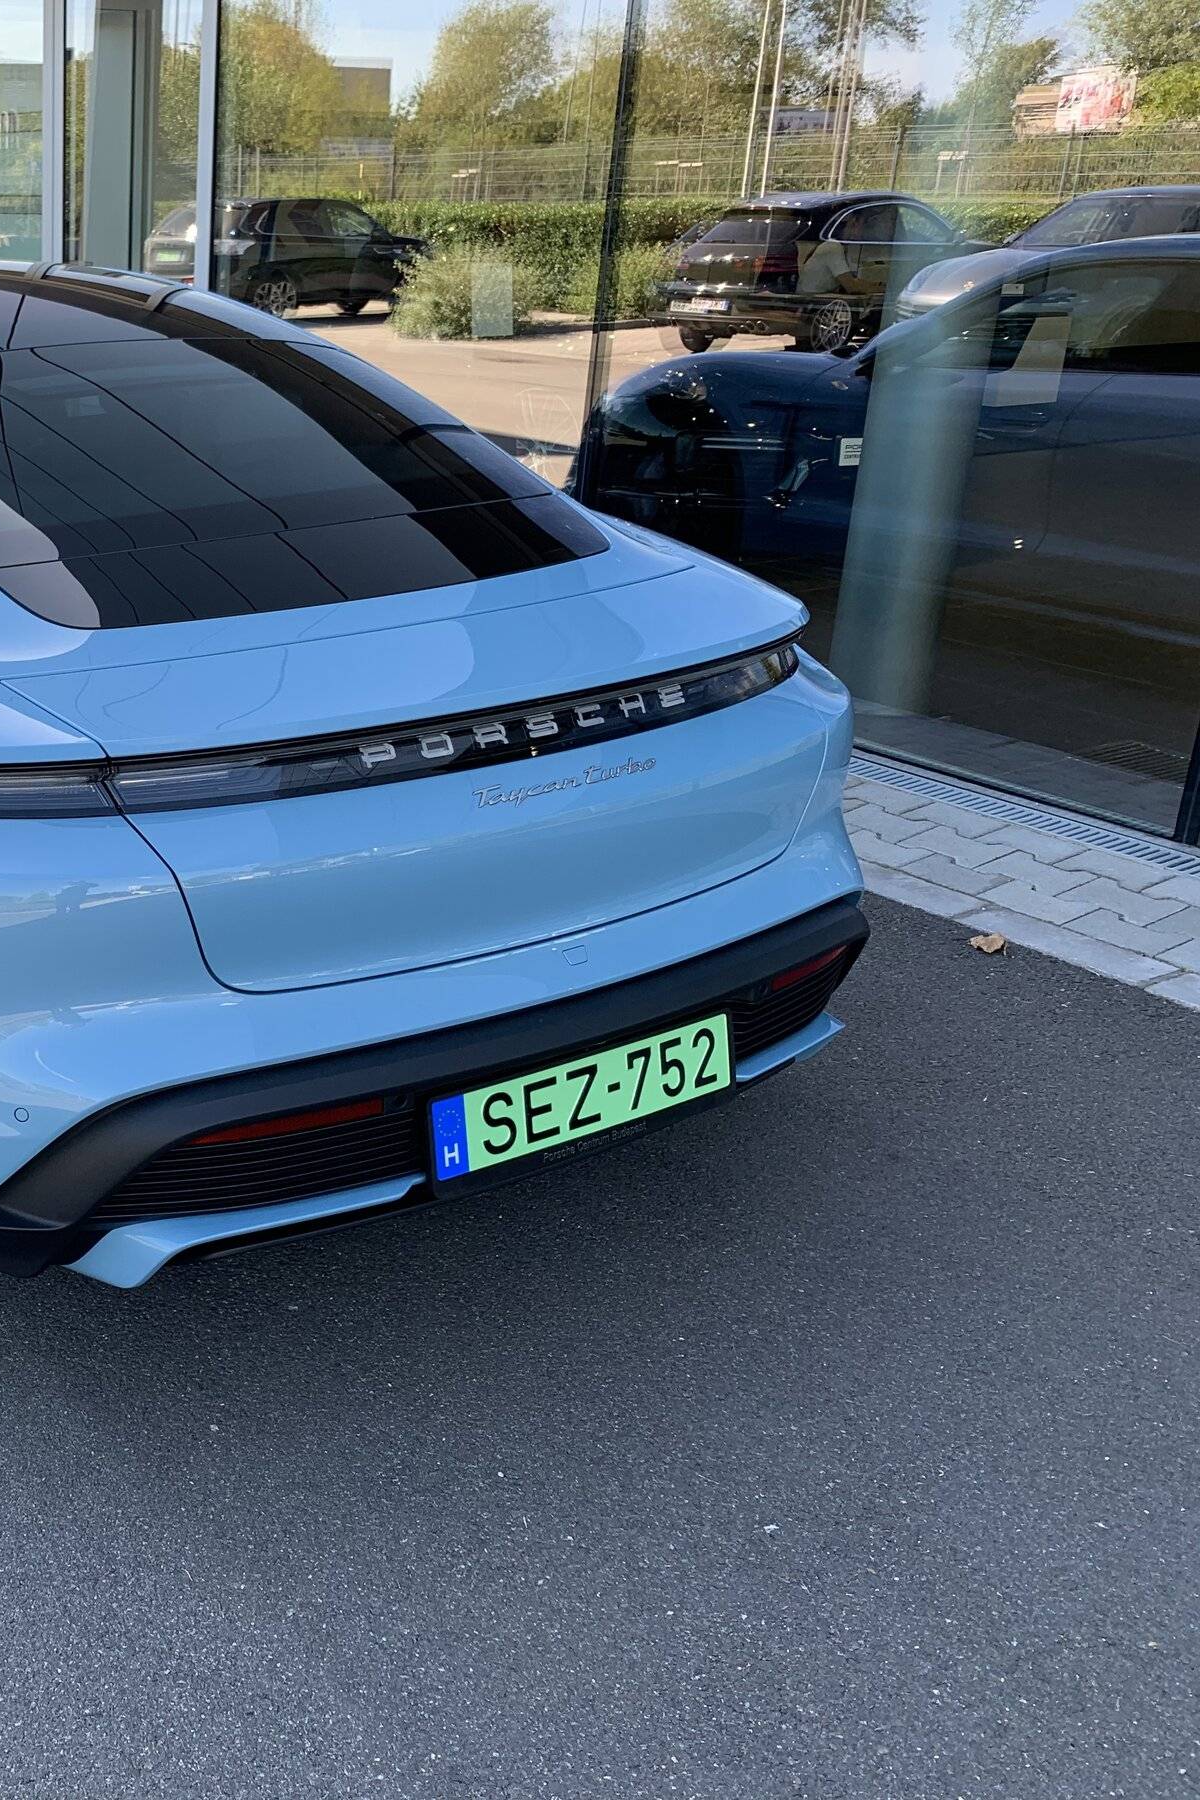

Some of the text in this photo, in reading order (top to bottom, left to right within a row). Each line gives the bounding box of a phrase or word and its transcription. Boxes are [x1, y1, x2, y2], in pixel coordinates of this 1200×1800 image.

[358, 684, 686, 769] PORSCHE
[472, 756, 657, 809] Taycan turbo
[482, 1027, 718, 1155] SEZ-752
[443, 1143, 460, 1168] H
